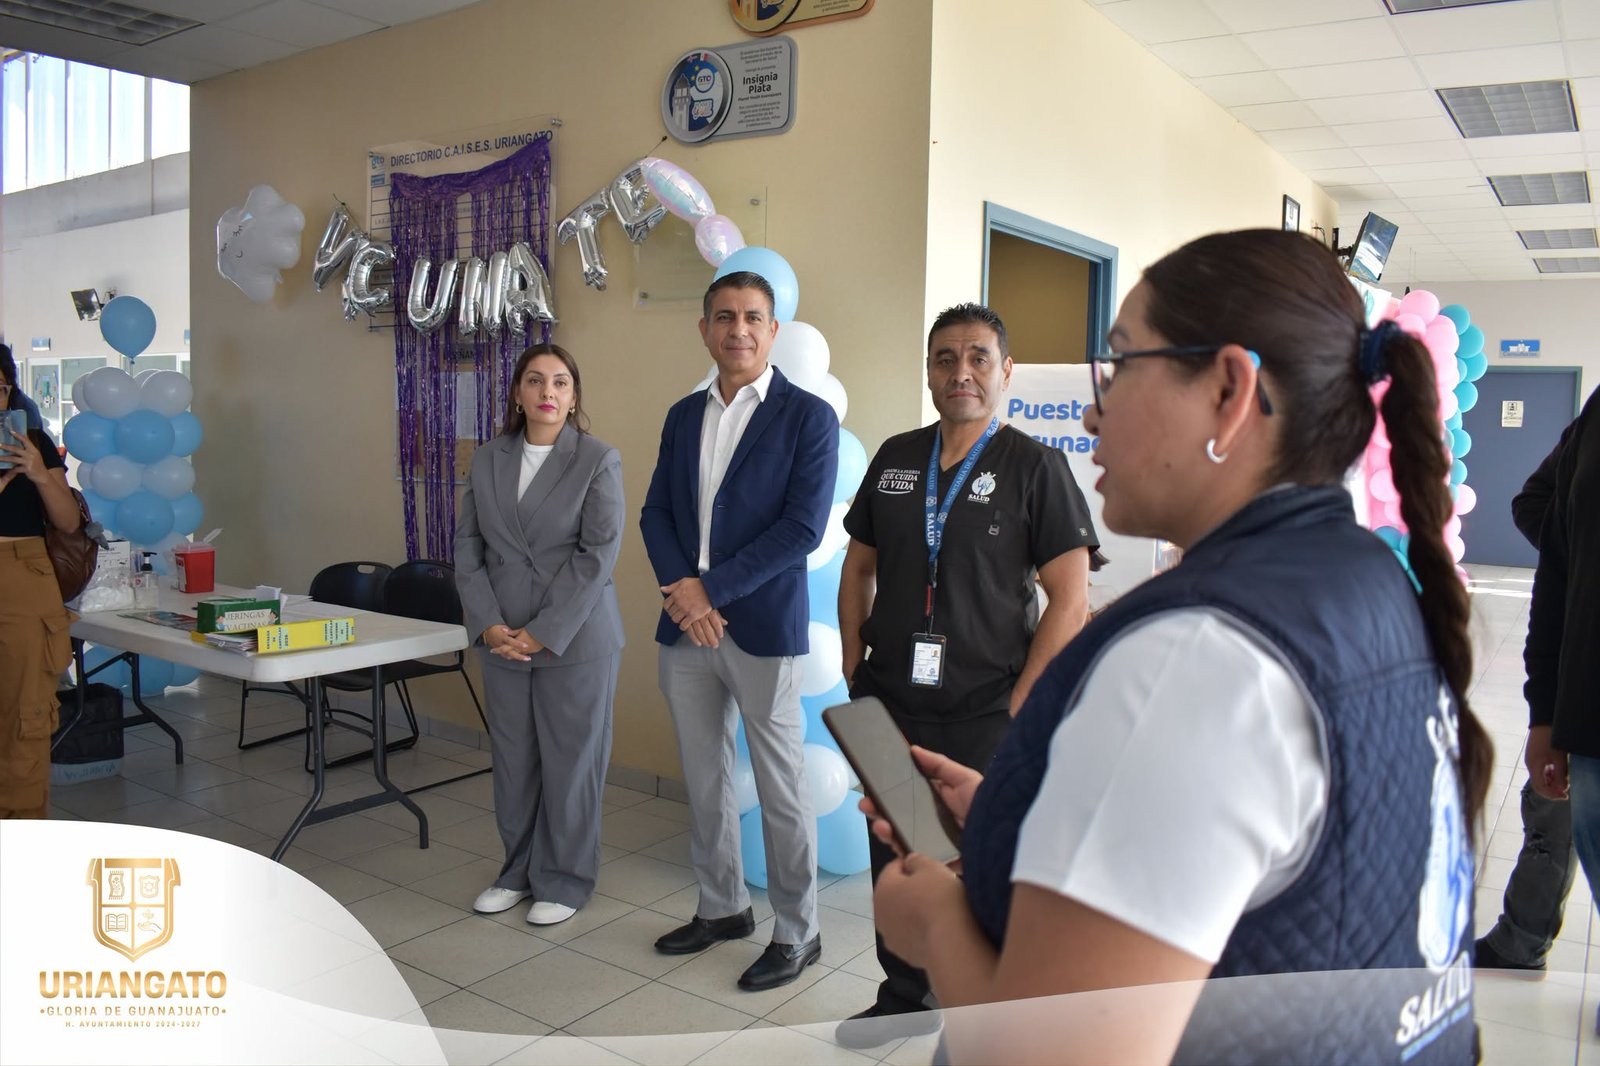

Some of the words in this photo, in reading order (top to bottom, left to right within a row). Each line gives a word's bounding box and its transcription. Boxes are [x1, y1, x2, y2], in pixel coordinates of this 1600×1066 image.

[743, 72, 778, 86] Insignia
[748, 84, 772, 94] Plata
[391, 148, 442, 167] DIRECTORIO
[444, 139, 492, 157] C.A.I.S.E.S.
[880, 472, 895, 481] QUE
[894, 473, 918, 482] CUIDA
[877, 480, 890, 489] TU
[890, 480, 914, 490] VIDA
[968, 493, 990, 502] SALUD
[927, 512, 935, 546] SALUD
[225, 610, 266, 621] JERINGAS
[1396, 951, 1471, 1045] SALUD
